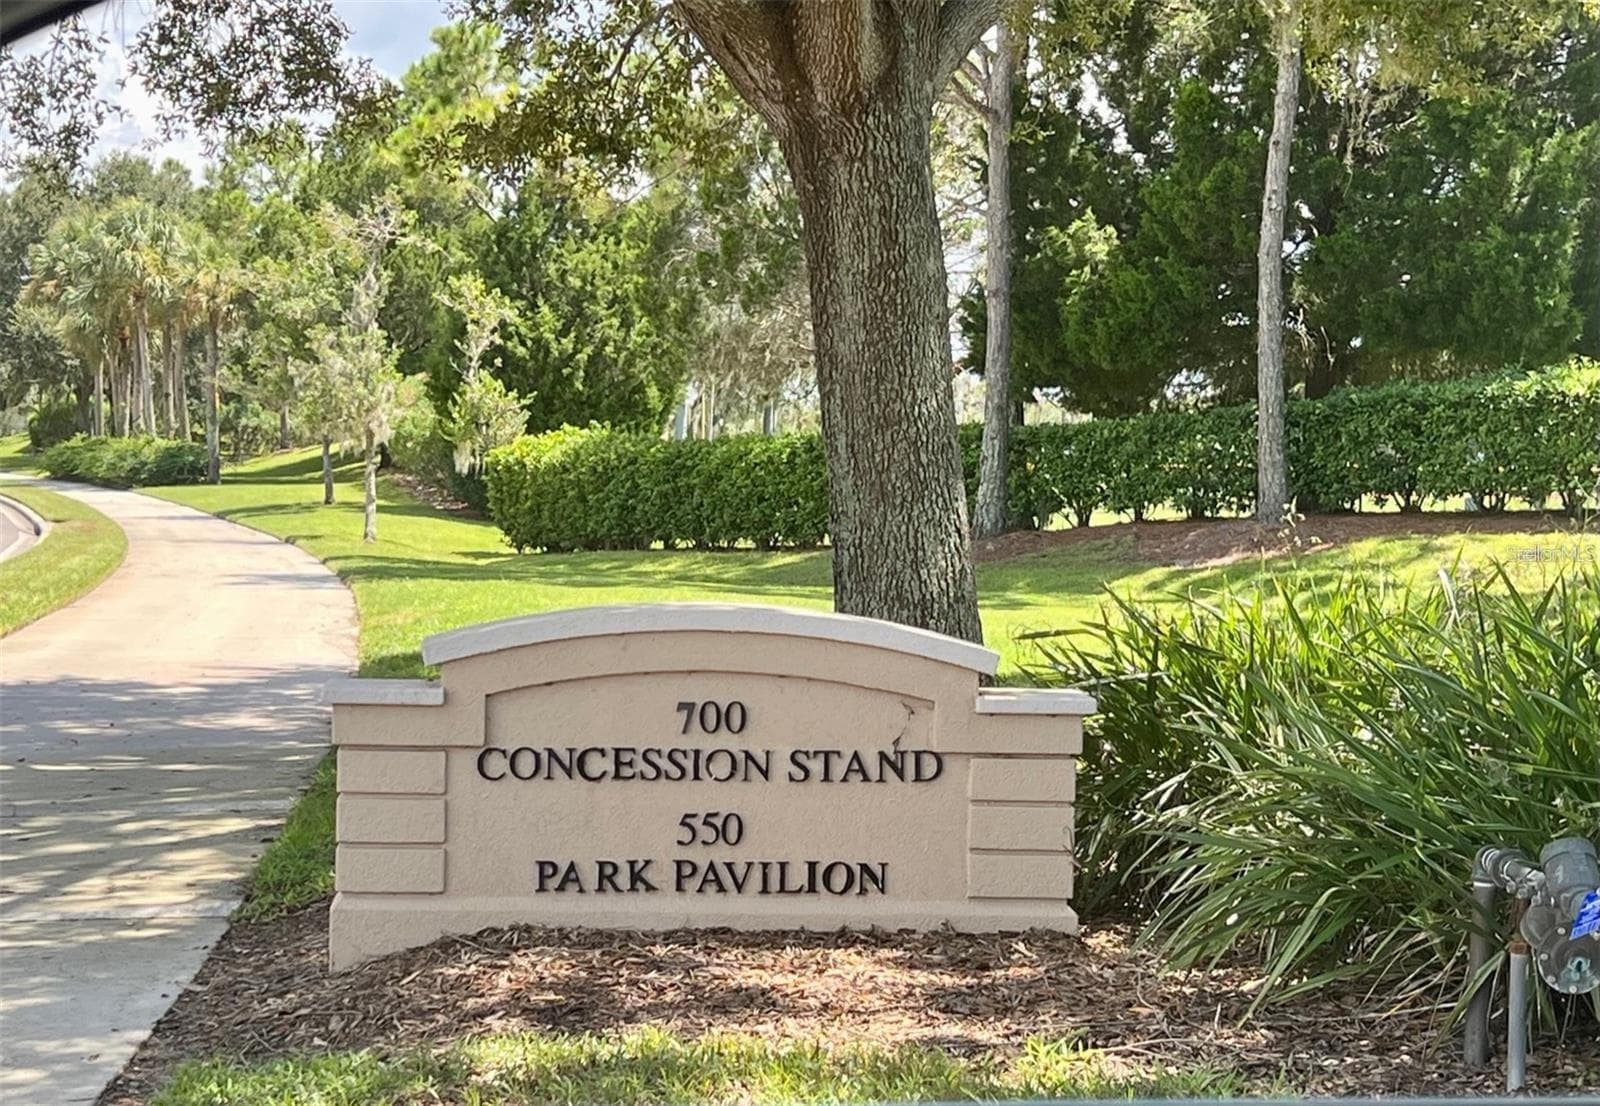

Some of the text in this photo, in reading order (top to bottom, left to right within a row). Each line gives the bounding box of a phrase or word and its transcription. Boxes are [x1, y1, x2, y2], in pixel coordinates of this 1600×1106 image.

[676, 700, 748, 735] 700
[477, 746, 944, 784] CONCESSION STAND
[676, 811, 744, 847] 550
[535, 859, 889, 896] PARK PAVILION
